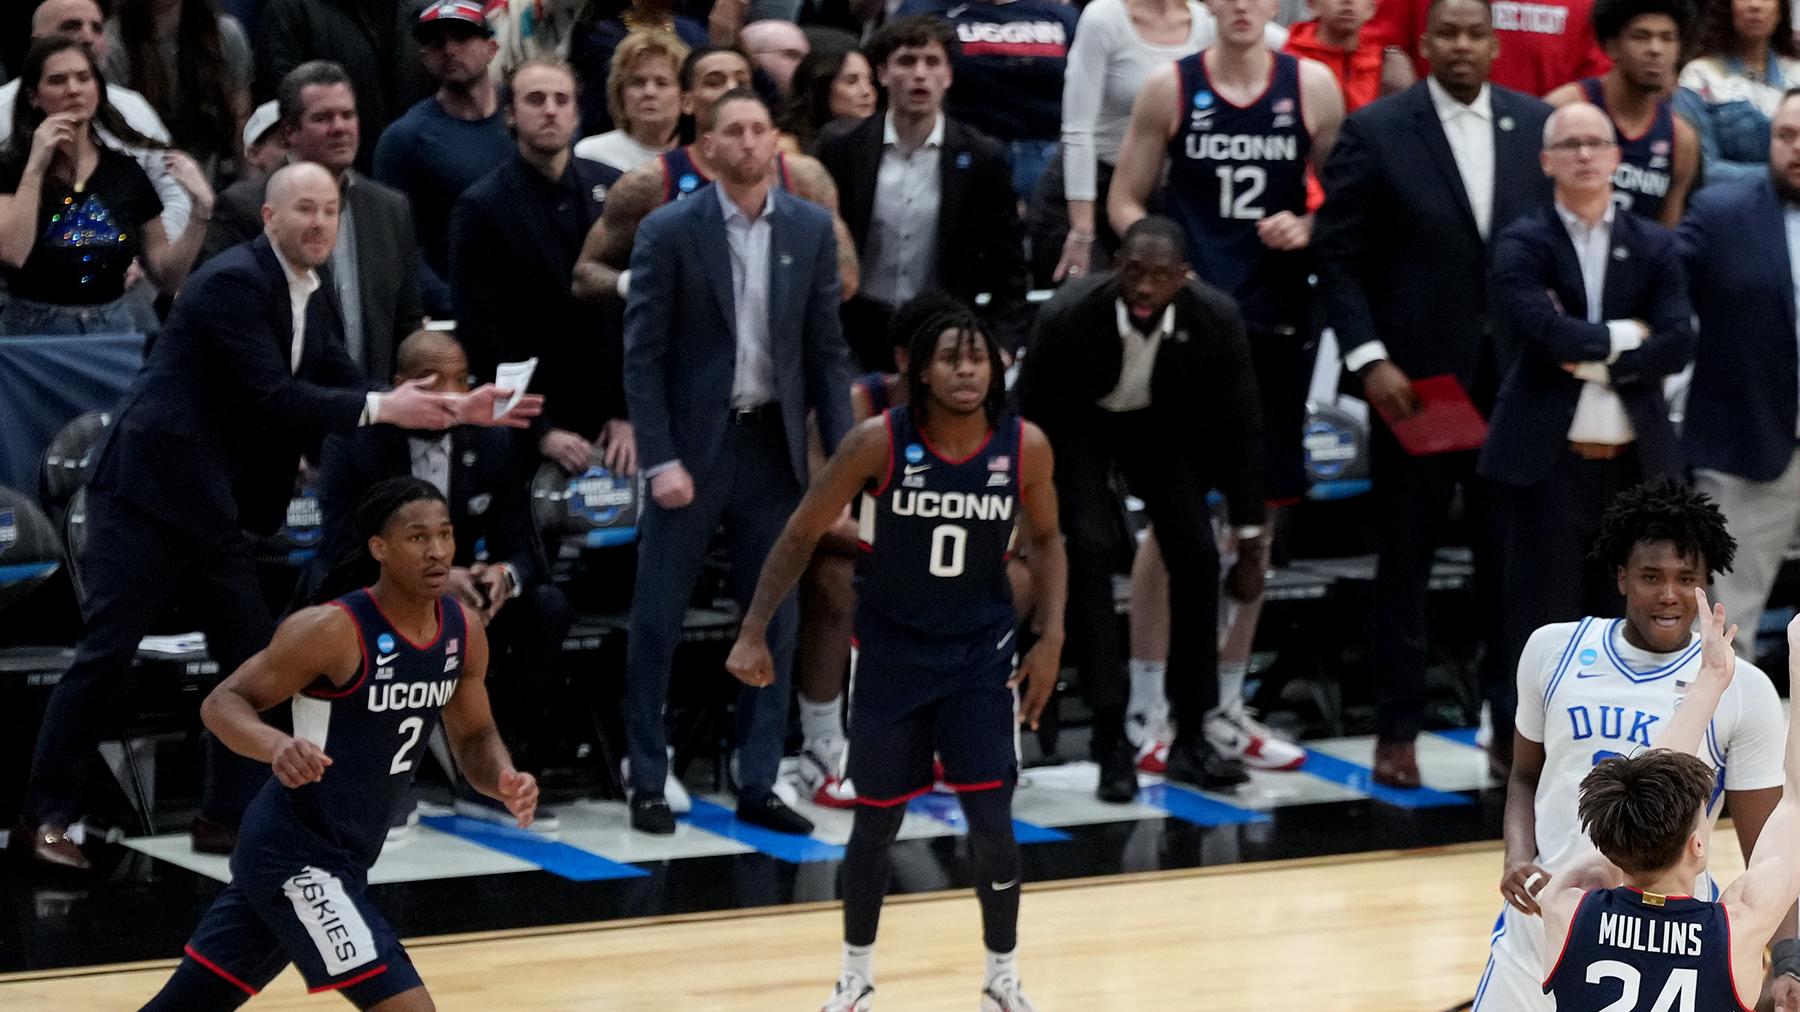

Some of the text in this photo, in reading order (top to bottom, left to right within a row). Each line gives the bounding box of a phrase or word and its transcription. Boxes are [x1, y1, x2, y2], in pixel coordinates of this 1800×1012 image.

[956, 21, 1066, 45] UCONN
[1185, 133, 1297, 161] UCONN
[1215, 165, 1268, 219] 12
[892, 489, 1014, 521] UCONN
[929, 524, 968, 577] 0
[368, 678, 458, 712] UCONN
[389, 716, 424, 775] 2
[1567, 705, 1660, 748] DUK
[1598, 912, 1703, 957] MULLINS
